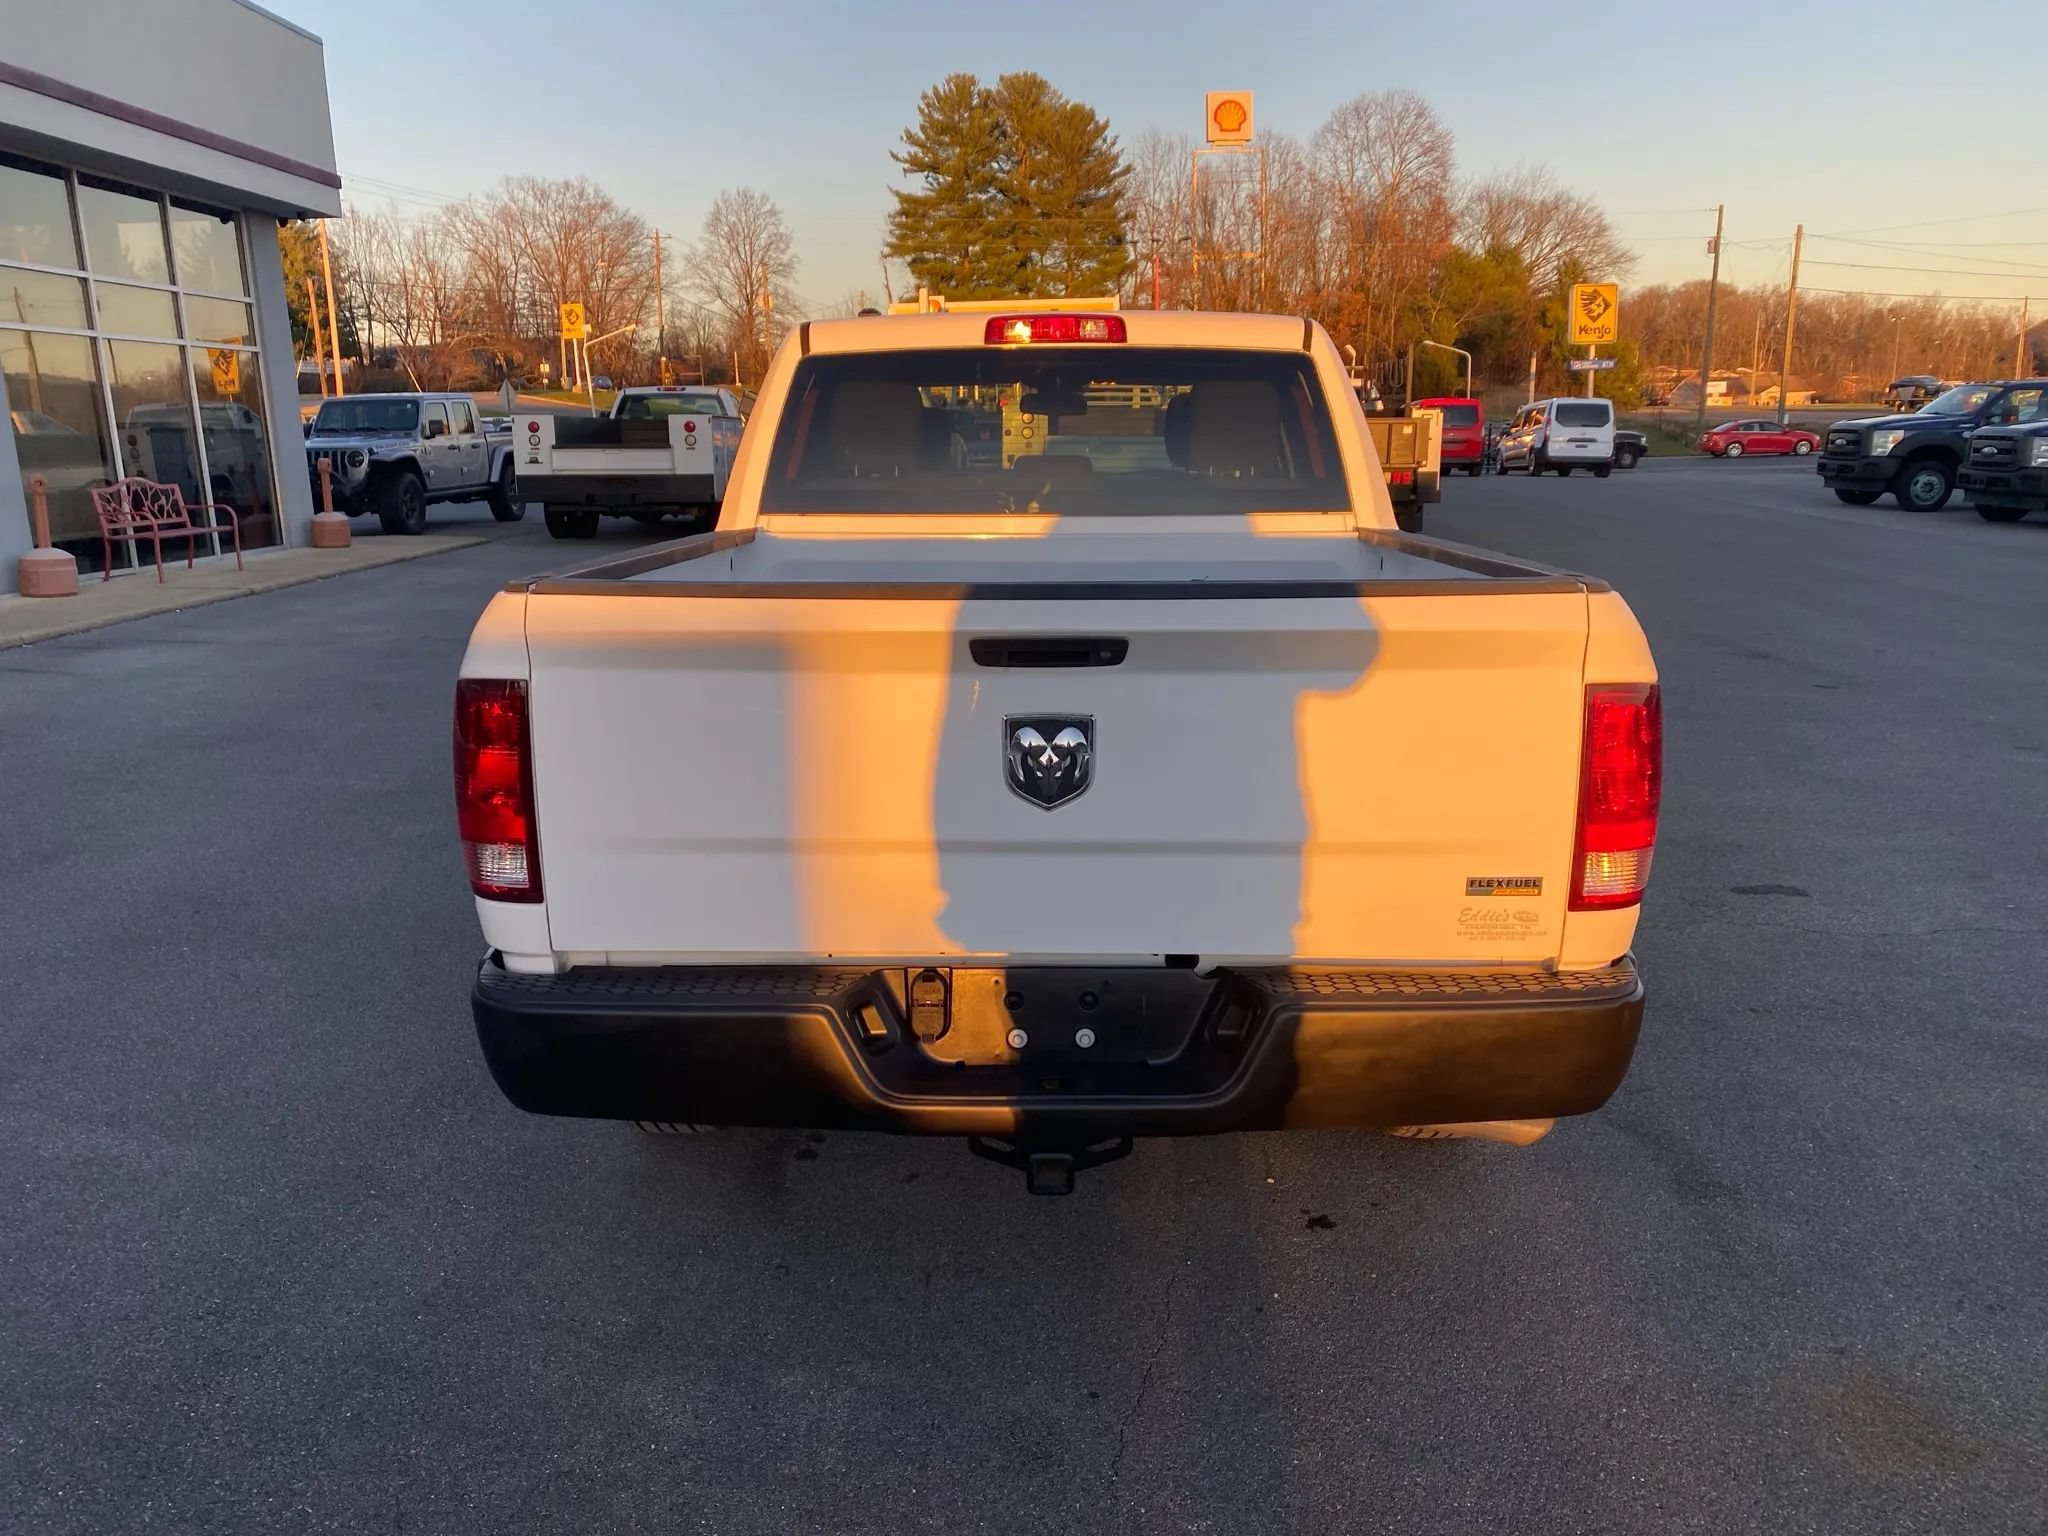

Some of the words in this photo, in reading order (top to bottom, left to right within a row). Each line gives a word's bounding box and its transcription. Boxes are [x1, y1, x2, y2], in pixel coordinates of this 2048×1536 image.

[1578, 324, 1611, 339] Kenjo
[1469, 879, 1540, 888] FLEXFUEL
[1458, 907, 1509, 922] Eddie's
